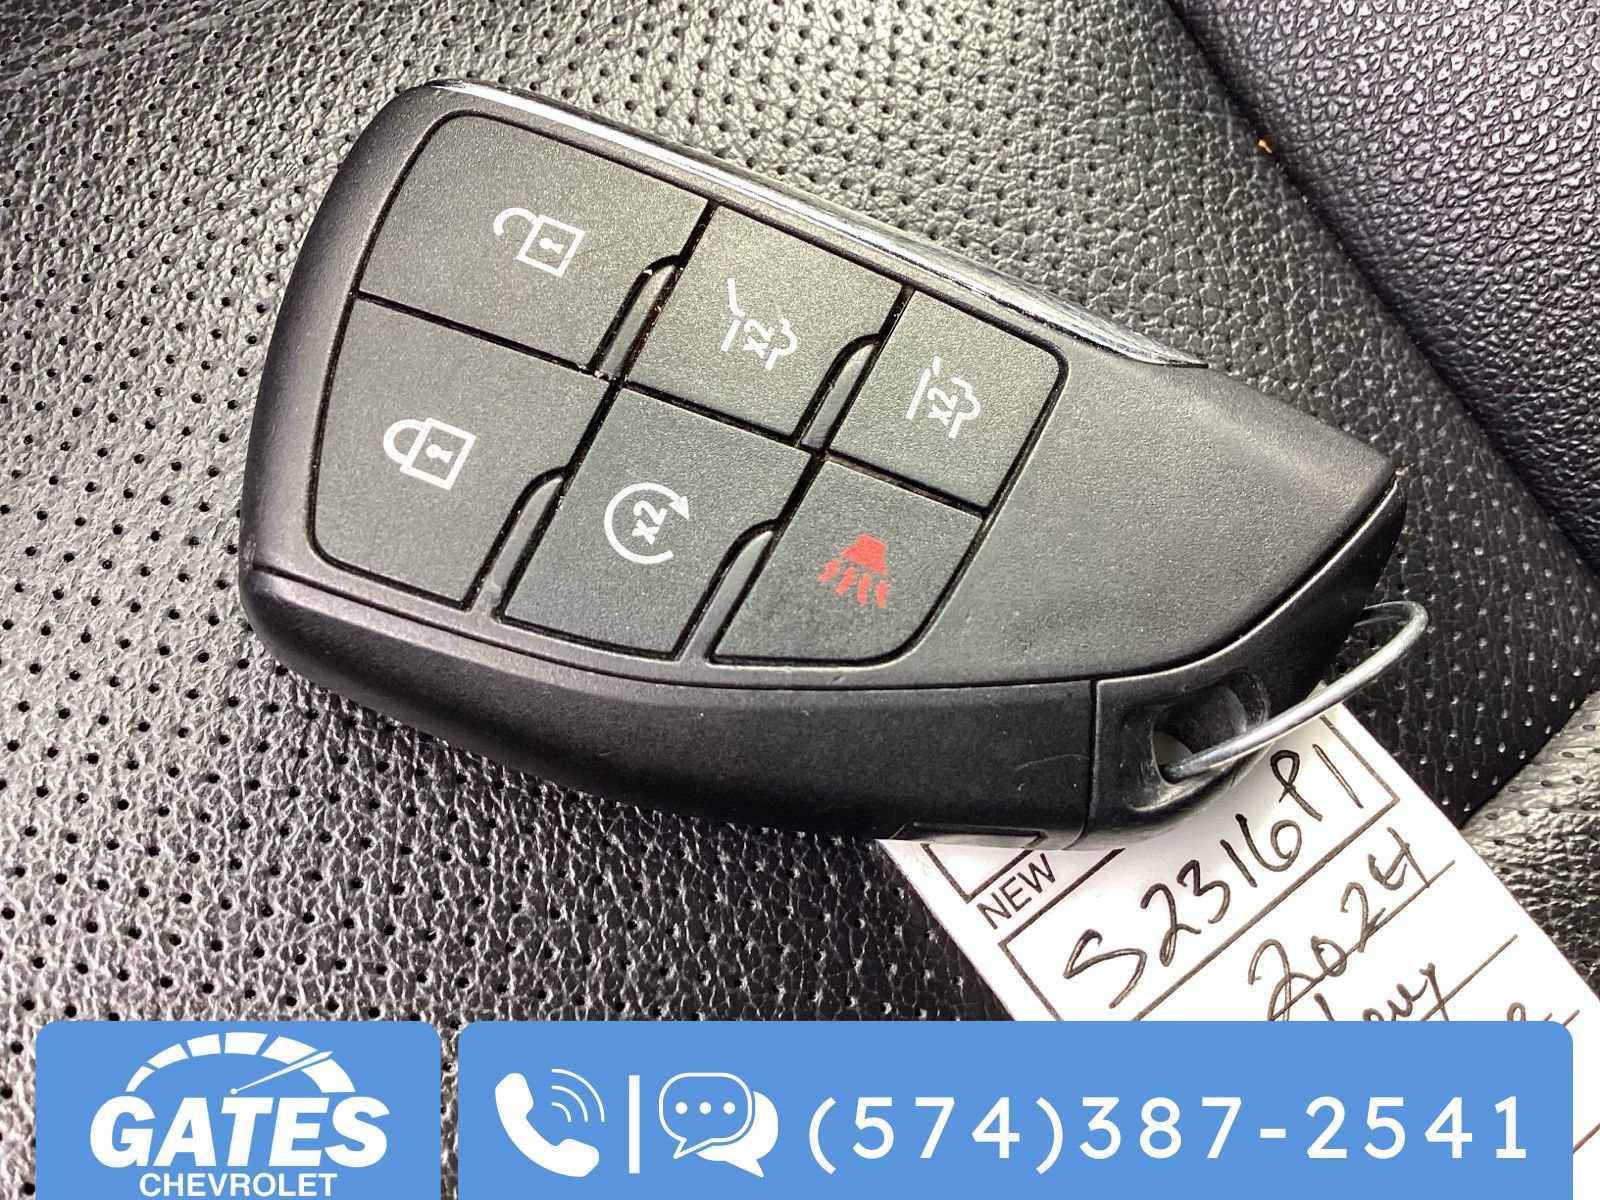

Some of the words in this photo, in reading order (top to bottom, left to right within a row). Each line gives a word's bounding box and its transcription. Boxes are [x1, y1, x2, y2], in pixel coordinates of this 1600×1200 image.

[743, 319, 774, 359] x2
[927, 386, 958, 426] x2
[632, 500, 667, 545] x2
[976, 852, 1056, 930] NEW
